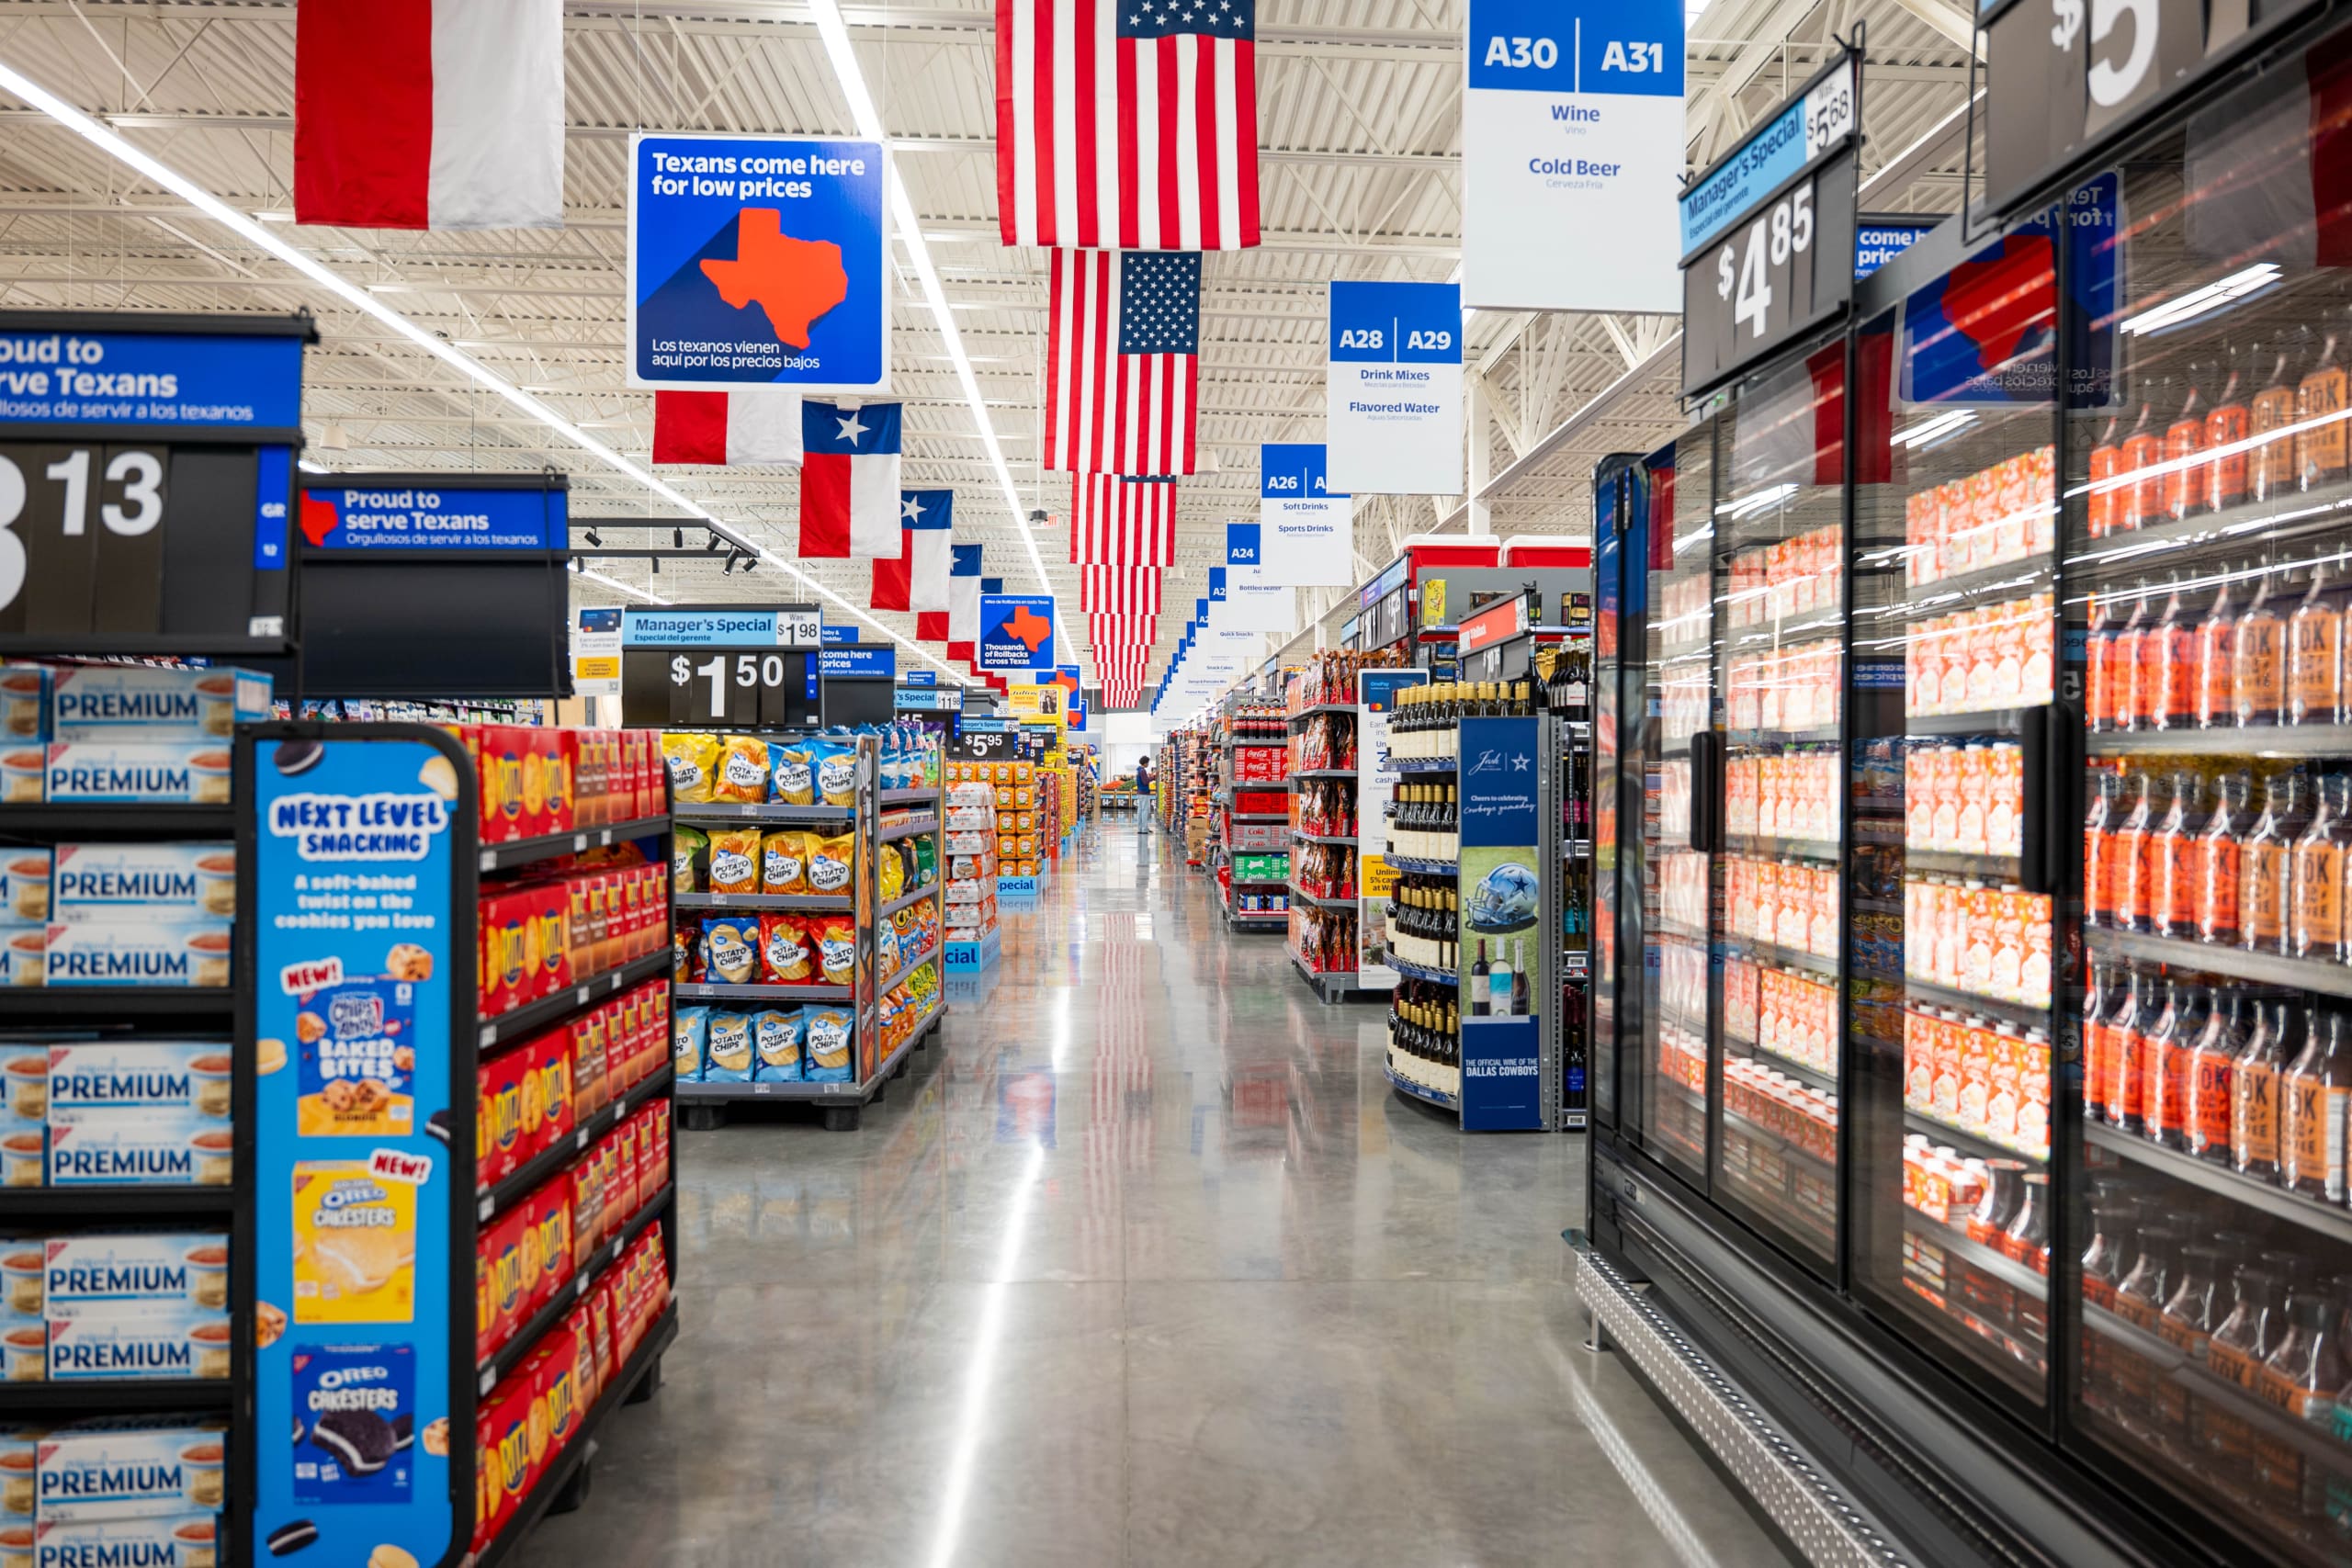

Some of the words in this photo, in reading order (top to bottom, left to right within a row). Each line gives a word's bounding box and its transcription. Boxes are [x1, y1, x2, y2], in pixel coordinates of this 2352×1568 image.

[1484, 36, 1558, 69] A30
[1600, 41, 1663, 73] A31
[1551, 105, 1600, 122] Wine
[1565, 125, 1587, 135] Vino
[652, 152, 737, 174] Texans
[740, 158, 807, 175] come
[810, 154, 865, 175] here
[1529, 158, 1572, 175] Cold
[1577, 160, 1621, 176] Beer
[1688, 158, 1748, 220] Manager's
[1750, 110, 1801, 171] Special
[651, 175, 688, 195] for
[692, 176, 735, 196] low
[739, 177, 812, 200] prices
[1545, 179, 1585, 189] Cerveza
[1860, 230, 1913, 245] come
[652, 338, 677, 352] Los
[678, 340, 732, 353] texanos
[734, 340, 780, 354] vienen
[1340, 330, 1384, 348] A28
[1408, 331, 1452, 350] A29
[67, 337, 104, 364] to
[652, 353, 683, 368] aquí
[684, 356, 707, 369] por
[710, 354, 730, 367] los
[732, 355, 781, 369] precios
[784, 355, 820, 370] bajos
[55, 368, 178, 398] Texans
[1361, 369, 1393, 379] Drink
[1396, 370, 1430, 380] Mixes
[53, 400, 79, 419] de
[81, 401, 132, 420] servir
[136, 406, 148, 420] a
[150, 402, 178, 420] los
[180, 404, 254, 422] texanos
[1350, 402, 1402, 412] Flavored
[1404, 403, 1440, 412] Water
[1268, 476, 1297, 490] A26
[345, 490, 413, 509] Proud
[416, 491, 441, 509] to
[1283, 502, 1300, 511] Soft
[1302, 502, 1329, 511] Drinks
[345, 513, 407, 530] serve
[411, 512, 489, 531] Texans
[1278, 525, 1306, 534] Sports
[1306, 525, 1334, 533] Drinks
[346, 533, 411, 546] Orgullosos
[413, 534, 428, 544] de
[429, 534, 461, 545] servir
[464, 536, 471, 545] a
[473, 534, 490, 545] los
[492, 535, 537, 546] texanos
[1231, 548, 1254, 558] A24
[635, 617, 714, 634] Manager's
[717, 617, 771, 634] Special
[634, 634, 666, 643] Especial
[667, 634, 679, 642] del
[680, 635, 712, 643] gerente
[850, 650, 872, 659] here
[823, 660, 851, 669] prices
[58, 694, 198, 717] PREMIUM
[905, 694, 934, 702] Special
[51, 769, 190, 792] PREMIUM
[779, 769, 810, 781] POTATO
[821, 771, 854, 784] POTATO
[1374, 774, 1392, 784] cash
[825, 779, 851, 789] CHIPS
[277, 802, 351, 828] NEXT
[359, 801, 440, 827] LEVEL
[307, 833, 422, 853] SNACKING
[715, 861, 749, 873] POTATO
[767, 869, 792, 881] CHIPS
[812, 866, 846, 879] POTATO
[59, 873, 197, 896] PREMIUM
[294, 875, 308, 890] A
[817, 874, 842, 885] CHIPS
[298, 893, 350, 909] twist
[352, 896, 377, 909] on
[380, 894, 413, 909] the
[275, 912, 350, 929] cookies
[353, 915, 390, 931] you
[392, 913, 435, 929] love
[715, 947, 747, 959] POTATO
[719, 955, 743, 965] CHIPS
[49, 952, 188, 976] PREMIUM
[288, 964, 338, 987] NEW!
[761, 1030, 793, 1042] POTATO
[764, 1038, 789, 1049] CHIPS
[319, 1039, 395, 1057] BAKED
[714, 1042, 740, 1052] CHIPS
[320, 1058, 394, 1078] BITES
[1477, 1058, 1501, 1066] OFFICIAL
[1503, 1058, 1517, 1066] WINE
[1519, 1058, 1526, 1066] OF
[1527, 1058, 1538, 1066] THE
[1466, 1066, 1498, 1077] DALLAS
[1498, 1066, 1539, 1077] COWBOYS
[51, 1074, 190, 1099] PREMIUM
[55, 1149, 191, 1174] PREMIUM
[374, 1155, 427, 1179] NEW!
[49, 1267, 186, 1293] PREMIUM
[53, 1342, 190, 1368] PREMIUM
[319, 1366, 388, 1388] OREO
[308, 1387, 398, 1411] CAKESTERS
[41, 1464, 182, 1495] PREMIUM
[40, 1542, 175, 1568] PREMIUM
